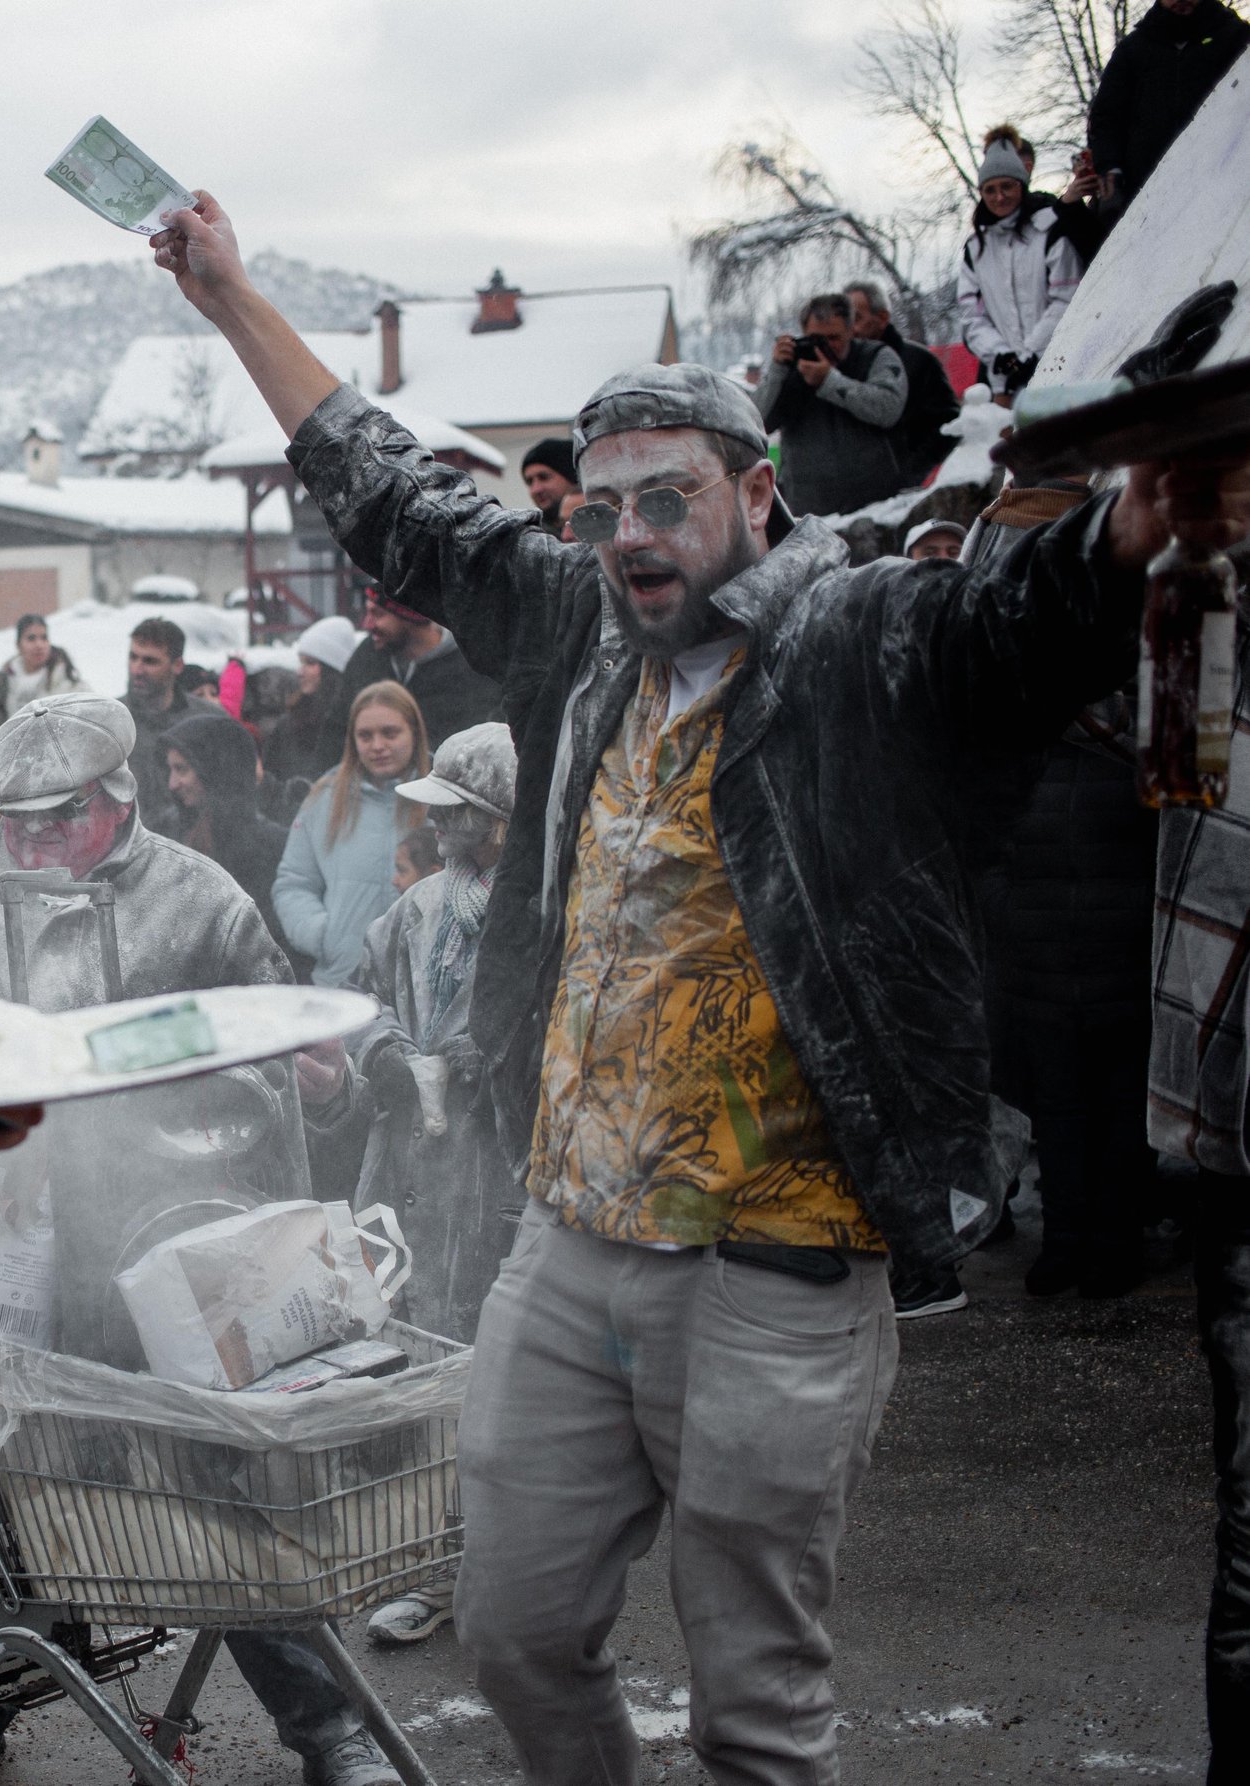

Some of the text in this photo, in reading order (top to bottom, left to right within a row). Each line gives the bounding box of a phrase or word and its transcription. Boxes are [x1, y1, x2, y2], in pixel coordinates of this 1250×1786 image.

[56, 161, 76, 181] 100
[280, 1307, 292, 1329] 400
[287, 1300, 299, 1324] ТИП
[292, 1293, 310, 1342] БРАШНО
[298, 1286, 318, 1346] ПЧЕНИЧНО
